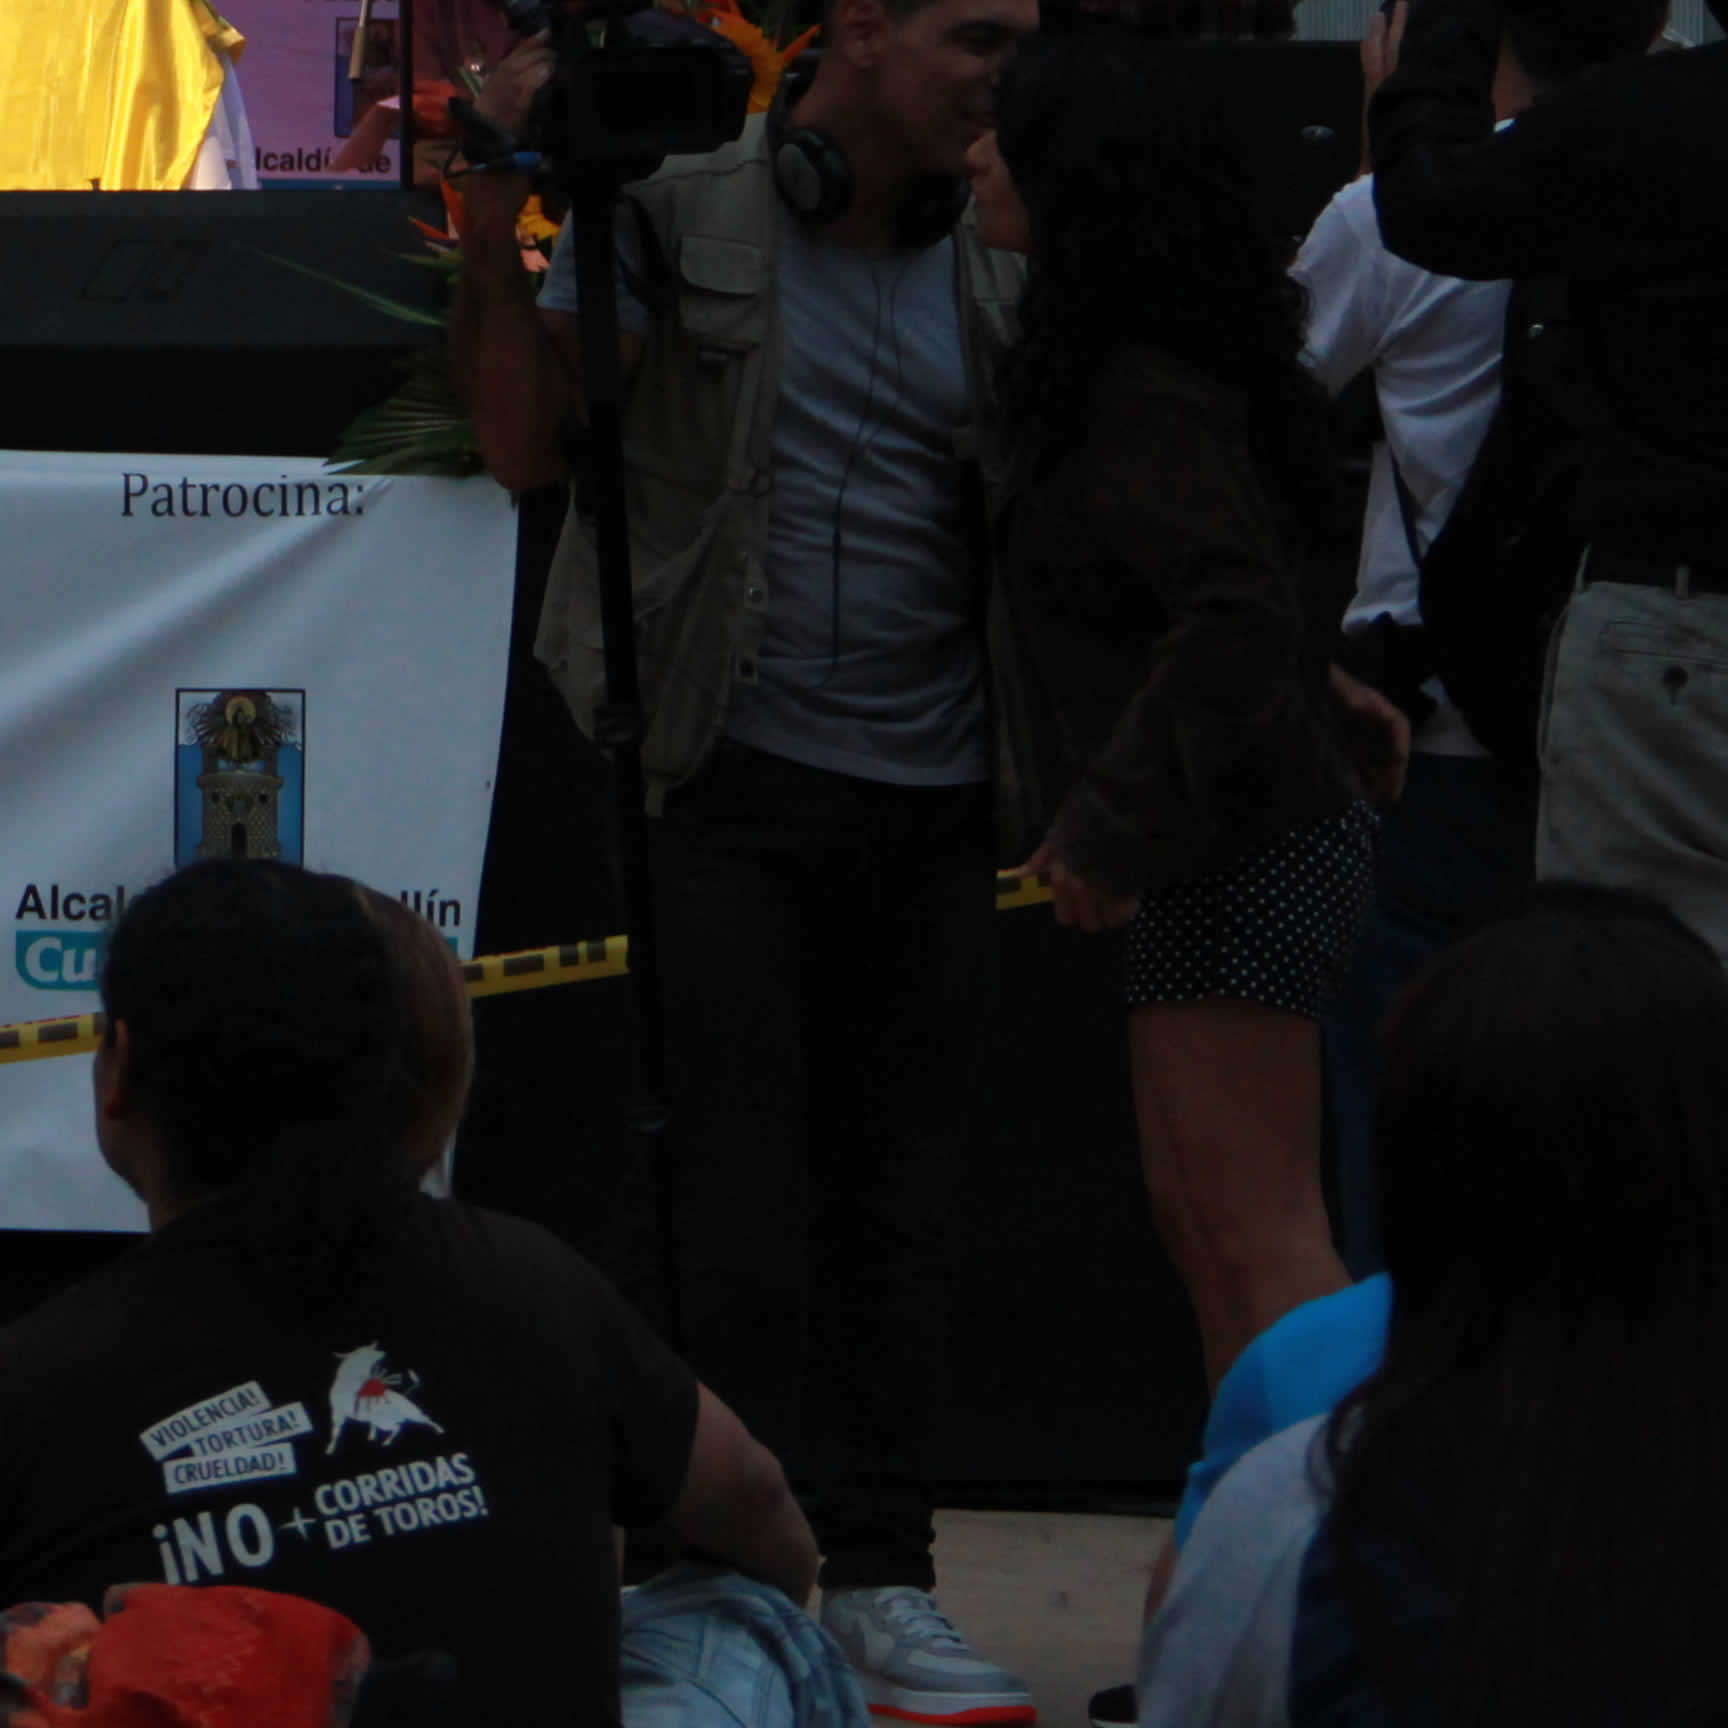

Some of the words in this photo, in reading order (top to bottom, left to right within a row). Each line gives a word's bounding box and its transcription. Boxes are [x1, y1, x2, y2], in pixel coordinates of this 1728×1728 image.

[121, 472, 364, 518] Patrocina:
[16, 884, 125, 922] Alcal
[149, 1385, 262, 1449] VIOLENCIA!
[194, 1409, 299, 1458] TORTURA!
[173, 1451, 285, 1486] CRUELDAD!
[313, 1451, 477, 1517] CORRIDAS
[323, 1513, 372, 1551] DE
[372, 1484, 490, 1537] TOROS!
